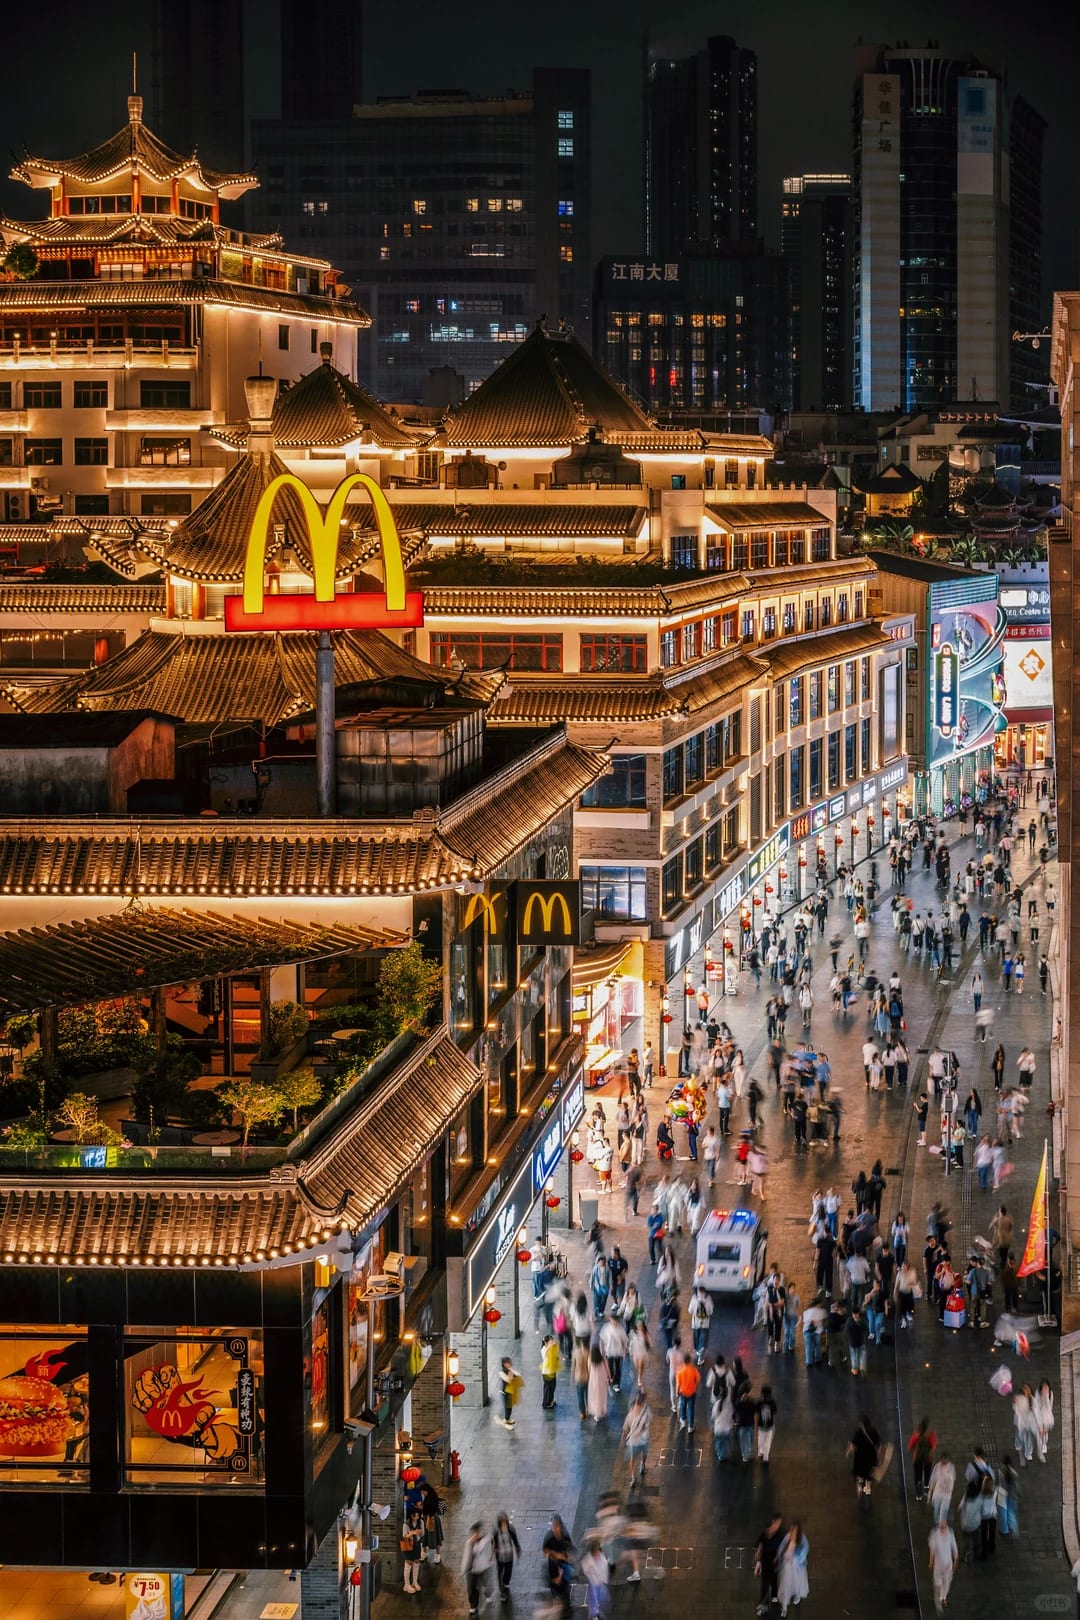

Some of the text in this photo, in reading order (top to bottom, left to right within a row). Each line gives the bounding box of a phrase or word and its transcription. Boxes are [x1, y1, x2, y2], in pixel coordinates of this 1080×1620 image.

[879, 80, 892, 153] 华佳广场
[611, 262, 680, 282] 江南大厦
[37, 1365, 49, 1377] 新
